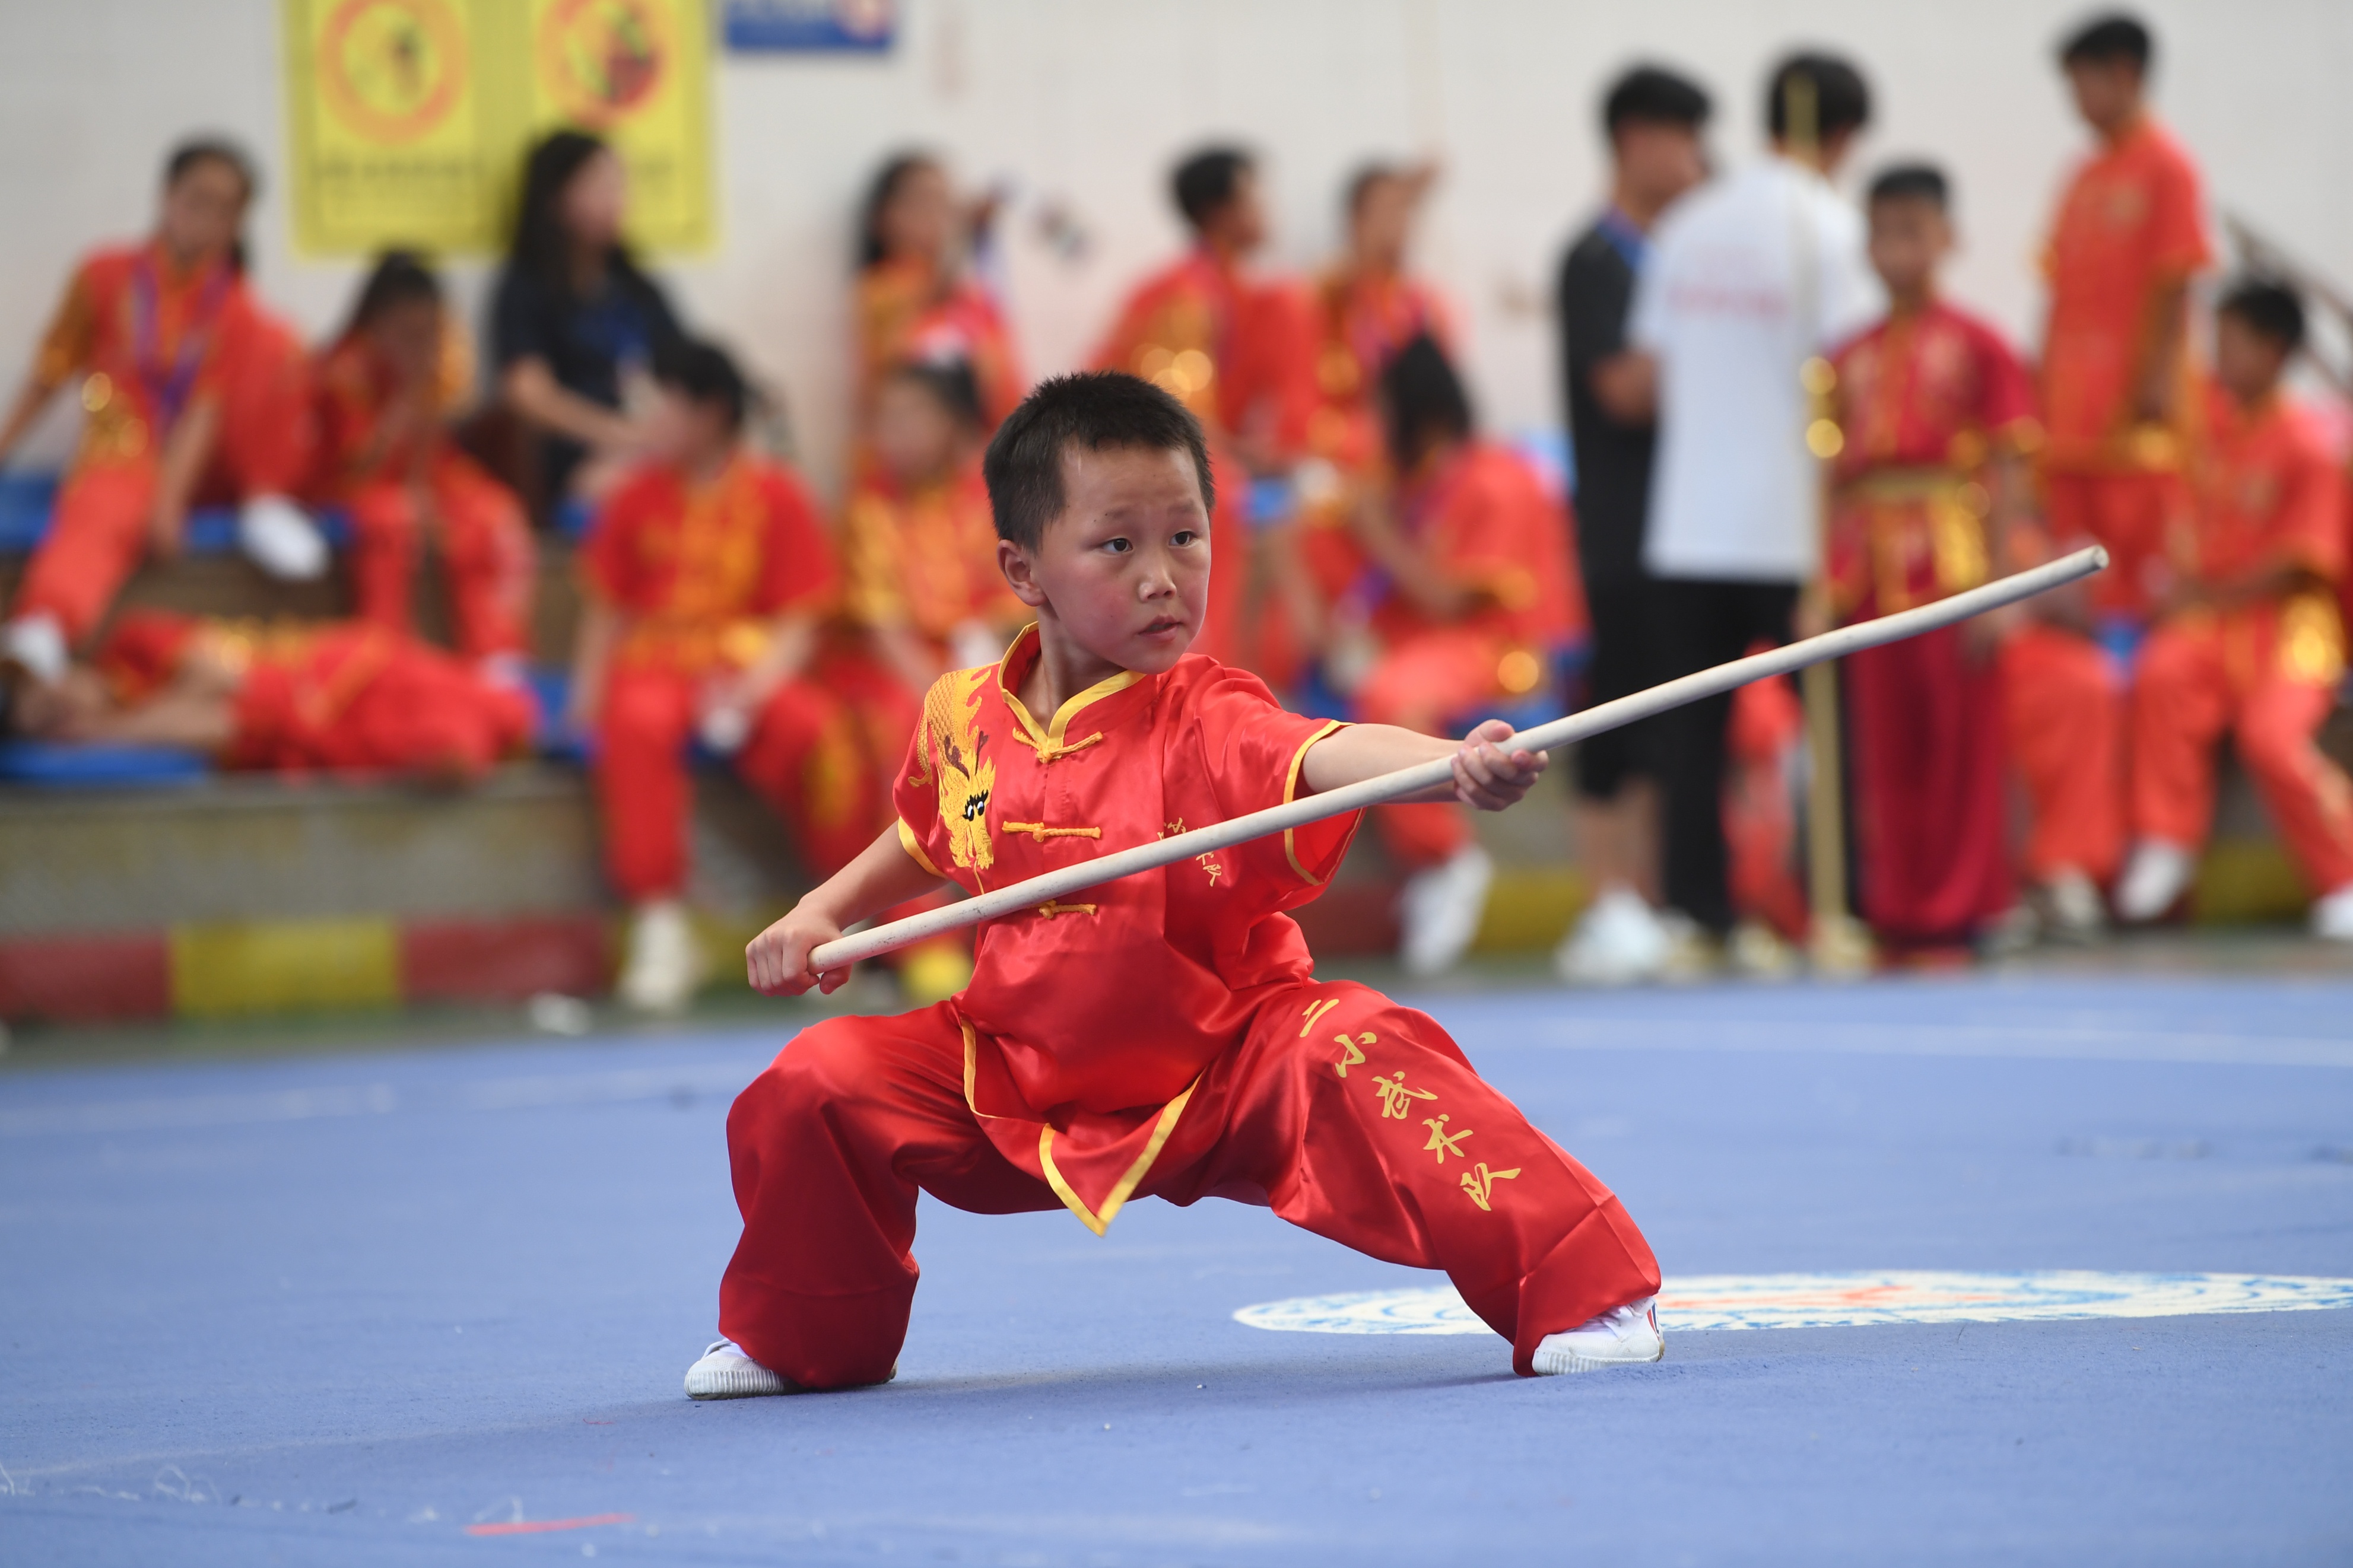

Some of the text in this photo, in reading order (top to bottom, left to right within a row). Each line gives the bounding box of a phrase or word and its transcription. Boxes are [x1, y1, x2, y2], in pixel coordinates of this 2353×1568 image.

[1300, 998, 1521, 1211] 二小武术队
